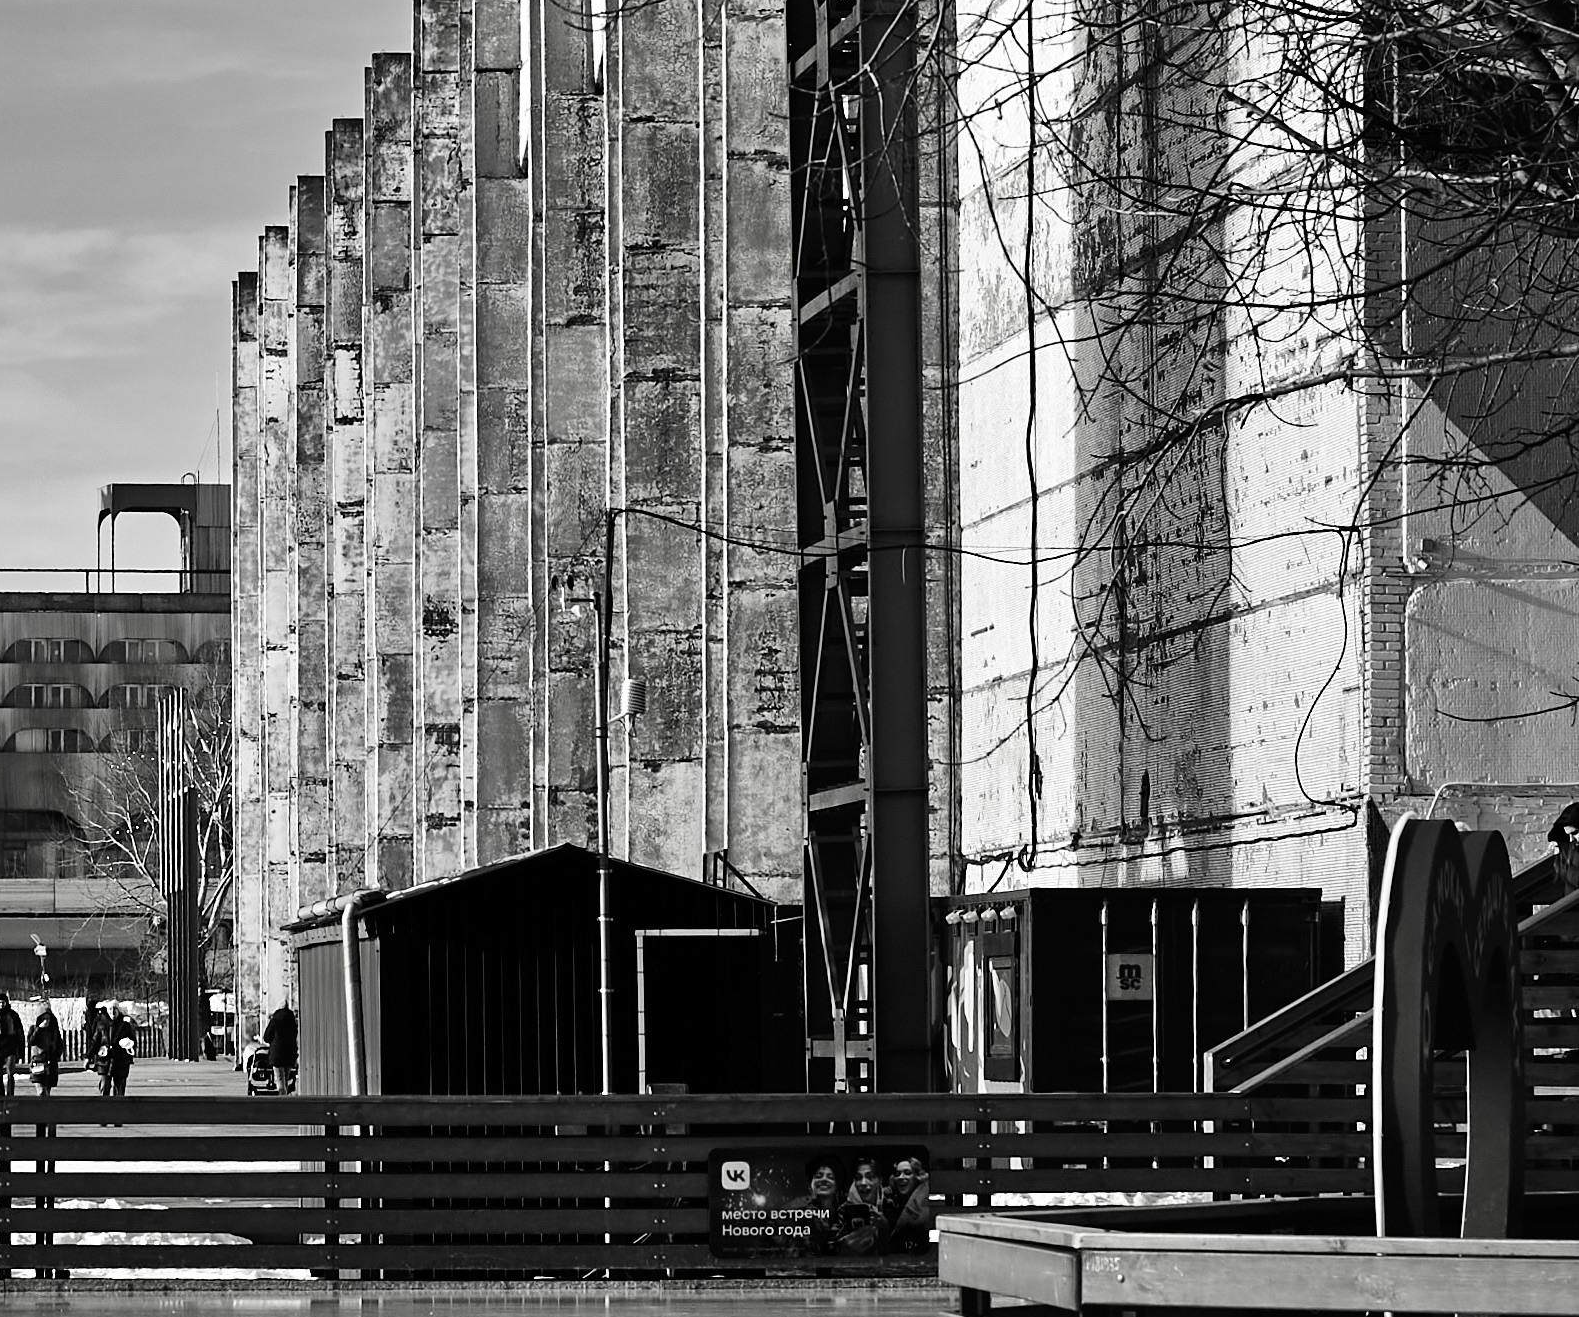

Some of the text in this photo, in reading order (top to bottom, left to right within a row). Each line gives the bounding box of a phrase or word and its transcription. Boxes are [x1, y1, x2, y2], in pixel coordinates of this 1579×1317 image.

[726, 1169, 745, 1182] VK
[722, 1208, 831, 1223] место встречи
[722, 1225, 811, 1238] Нового года
